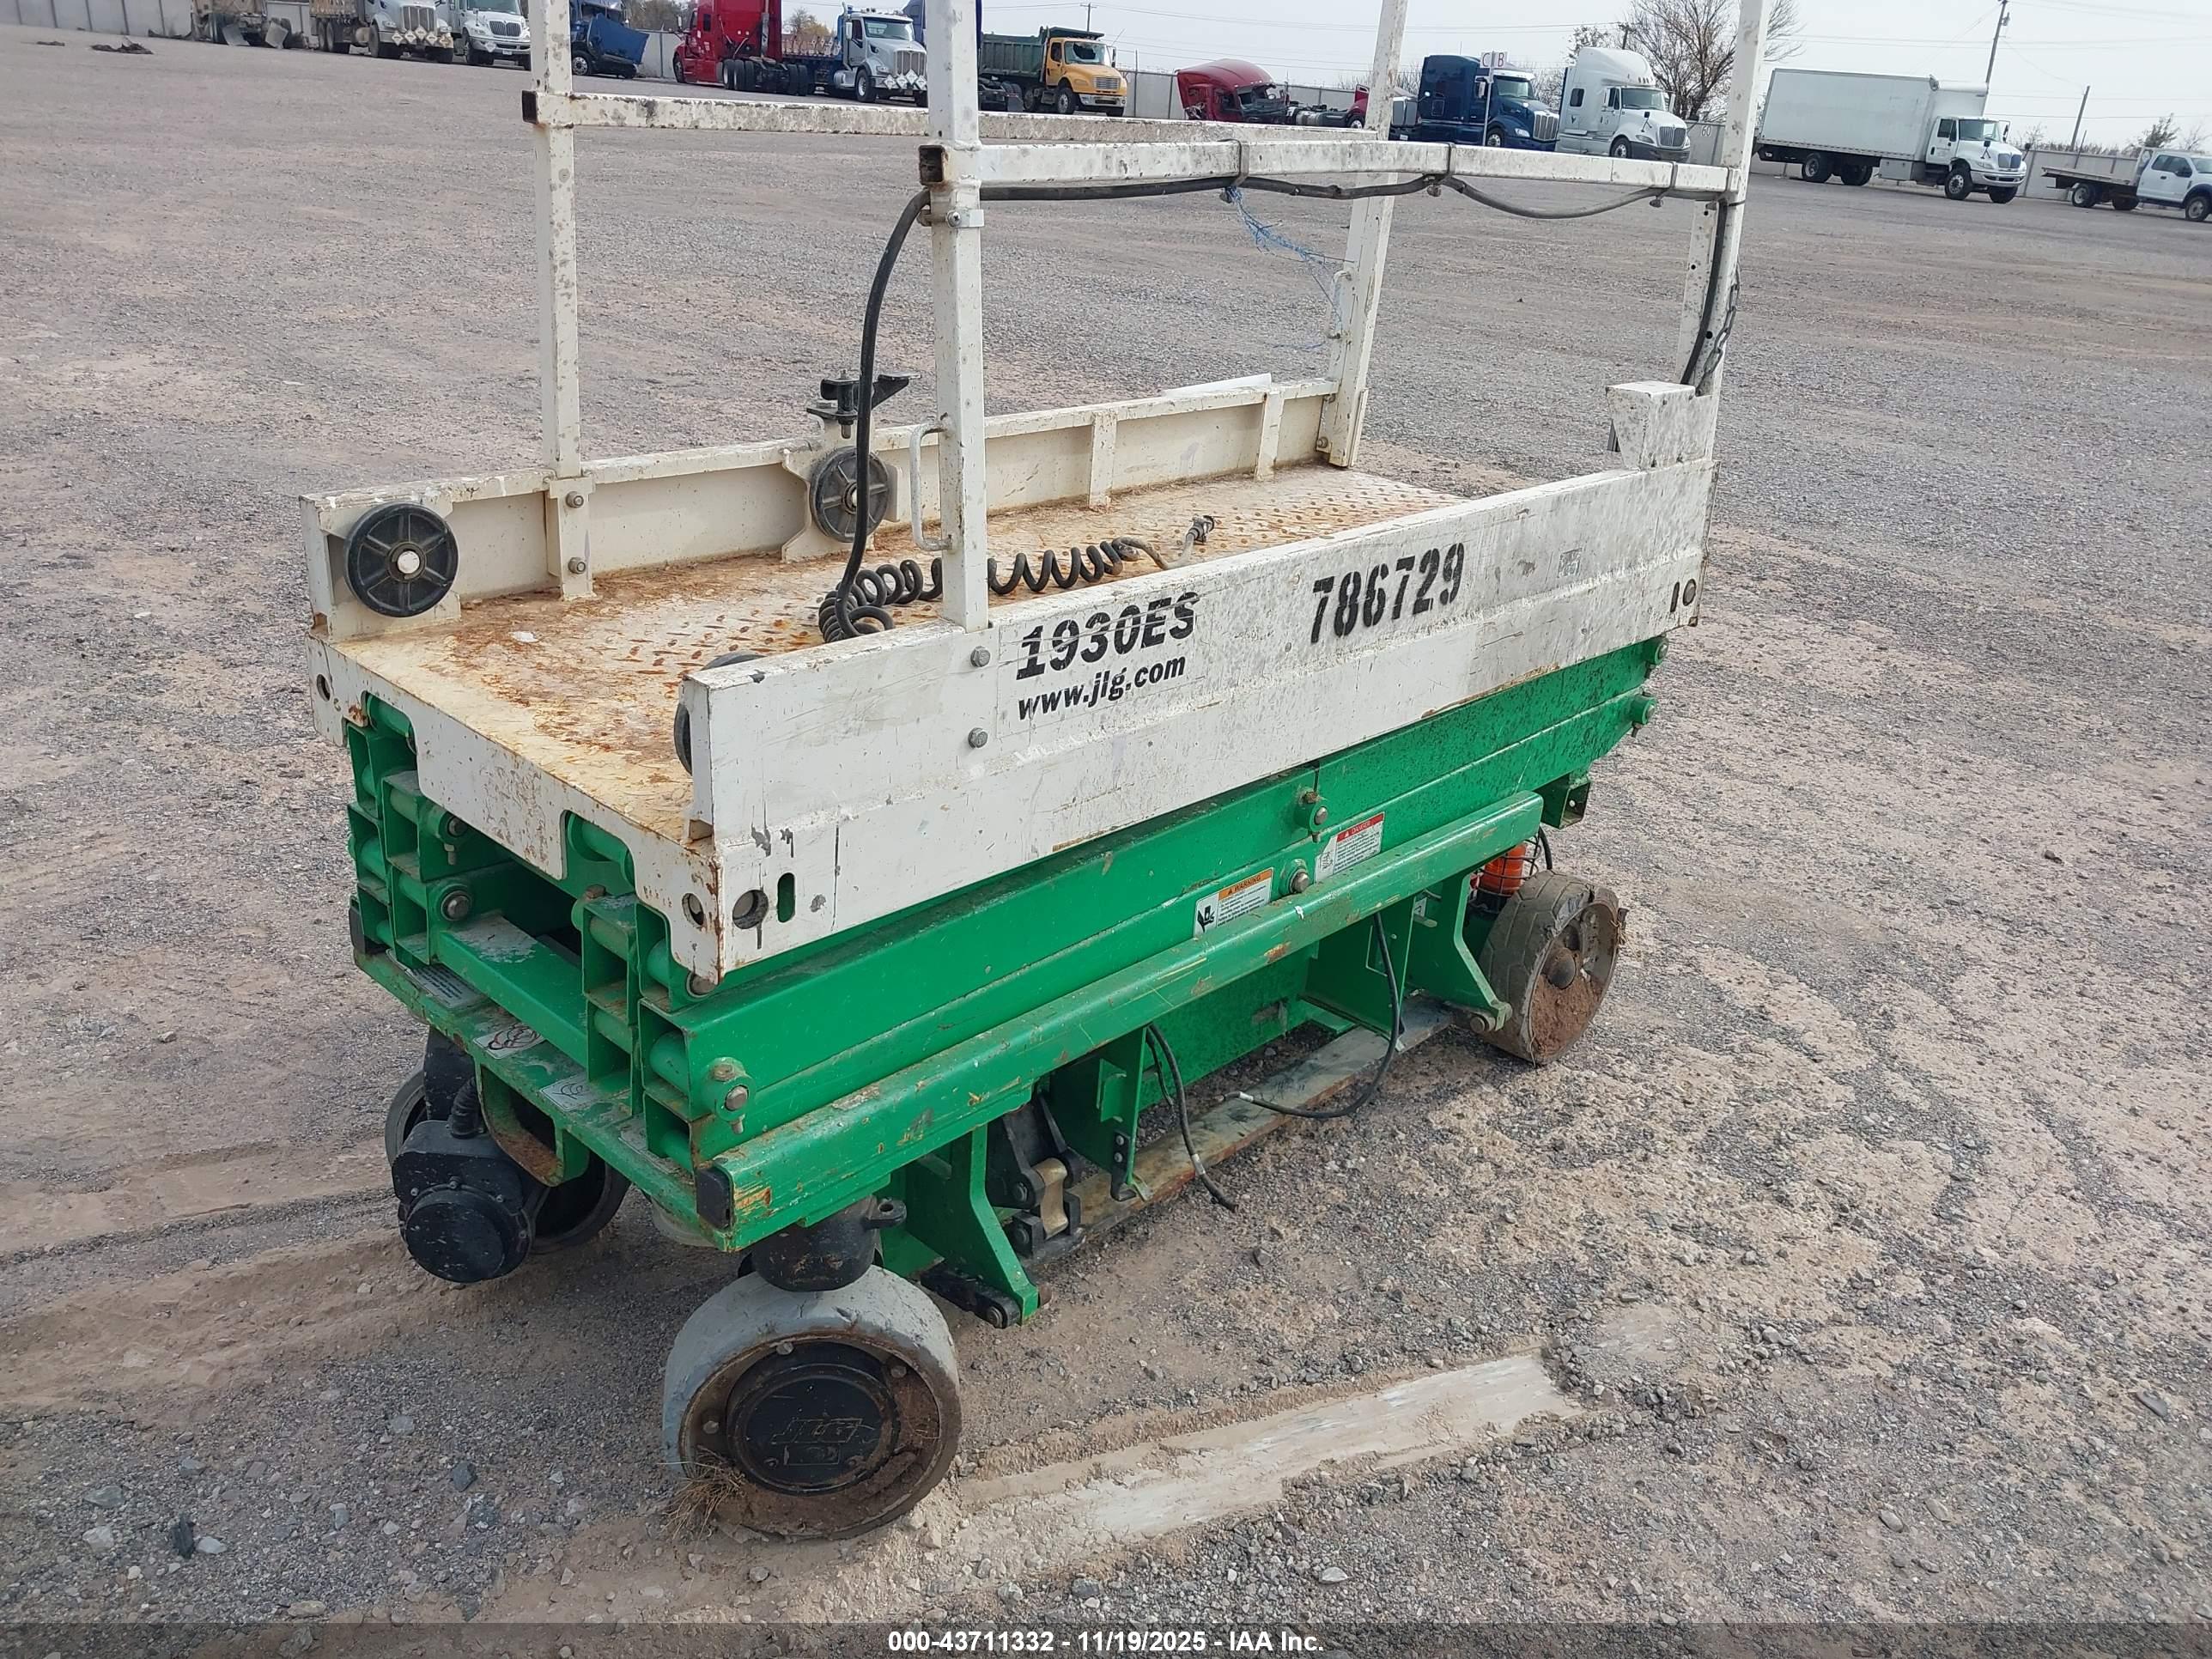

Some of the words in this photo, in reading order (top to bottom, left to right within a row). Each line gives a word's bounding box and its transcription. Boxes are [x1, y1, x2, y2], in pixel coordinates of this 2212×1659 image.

[1482, 52, 1491, 67] C
[1497, 52, 1505, 67] B
[1702, 125, 1711, 137] 60
[1310, 542, 1465, 644] 786729
[1016, 591, 1200, 681] 1930ES
[1018, 656, 1187, 721] www.jlg.com
[1234, 875, 1261, 892] WARNING
